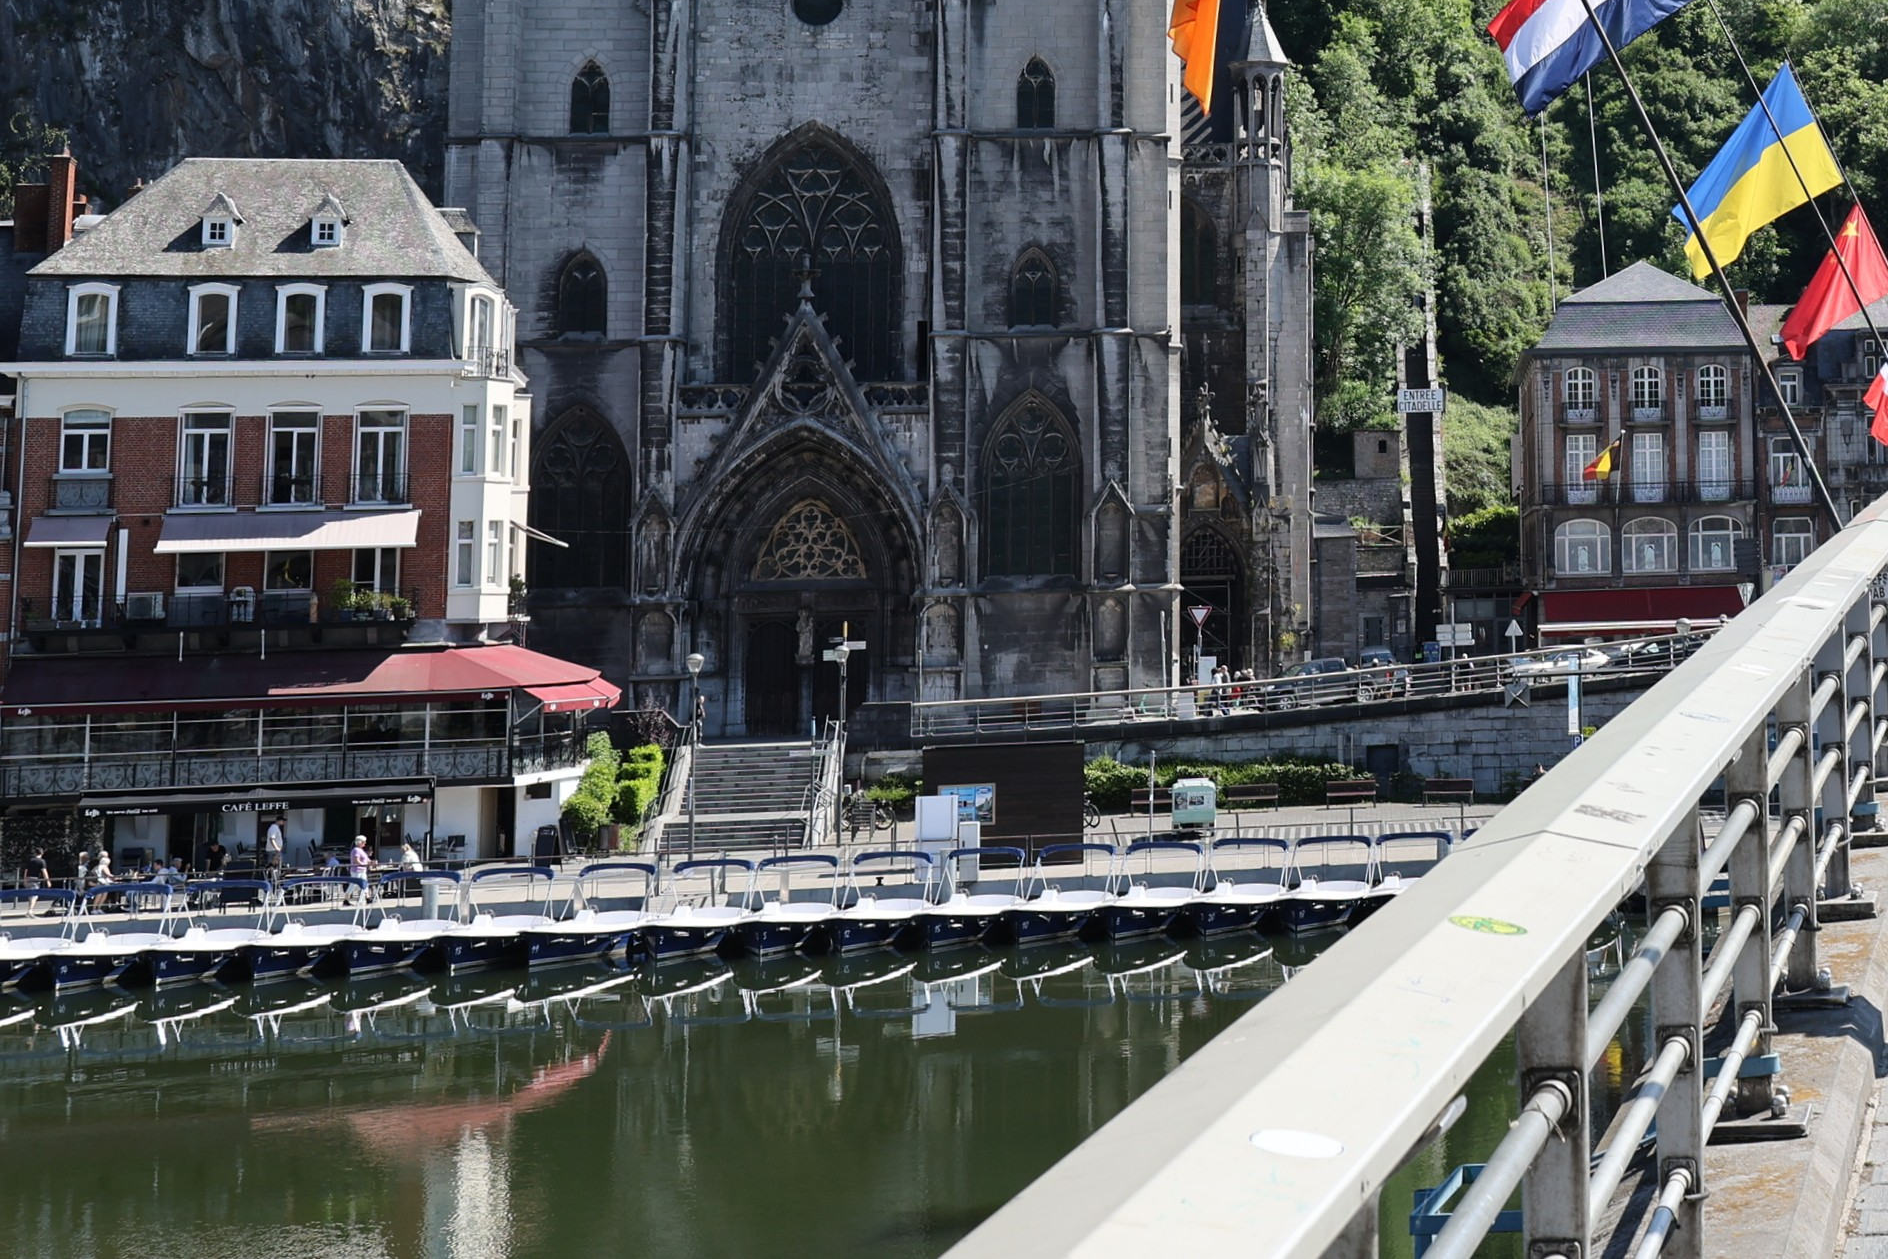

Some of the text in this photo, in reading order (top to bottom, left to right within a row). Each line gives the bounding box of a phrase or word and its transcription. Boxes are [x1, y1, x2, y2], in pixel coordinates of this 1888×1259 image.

[1399, 401, 1442, 411] CITADELLE
[1574, 737, 1581, 747] P
[222, 801, 289, 812] CAFÉ LEFFE
